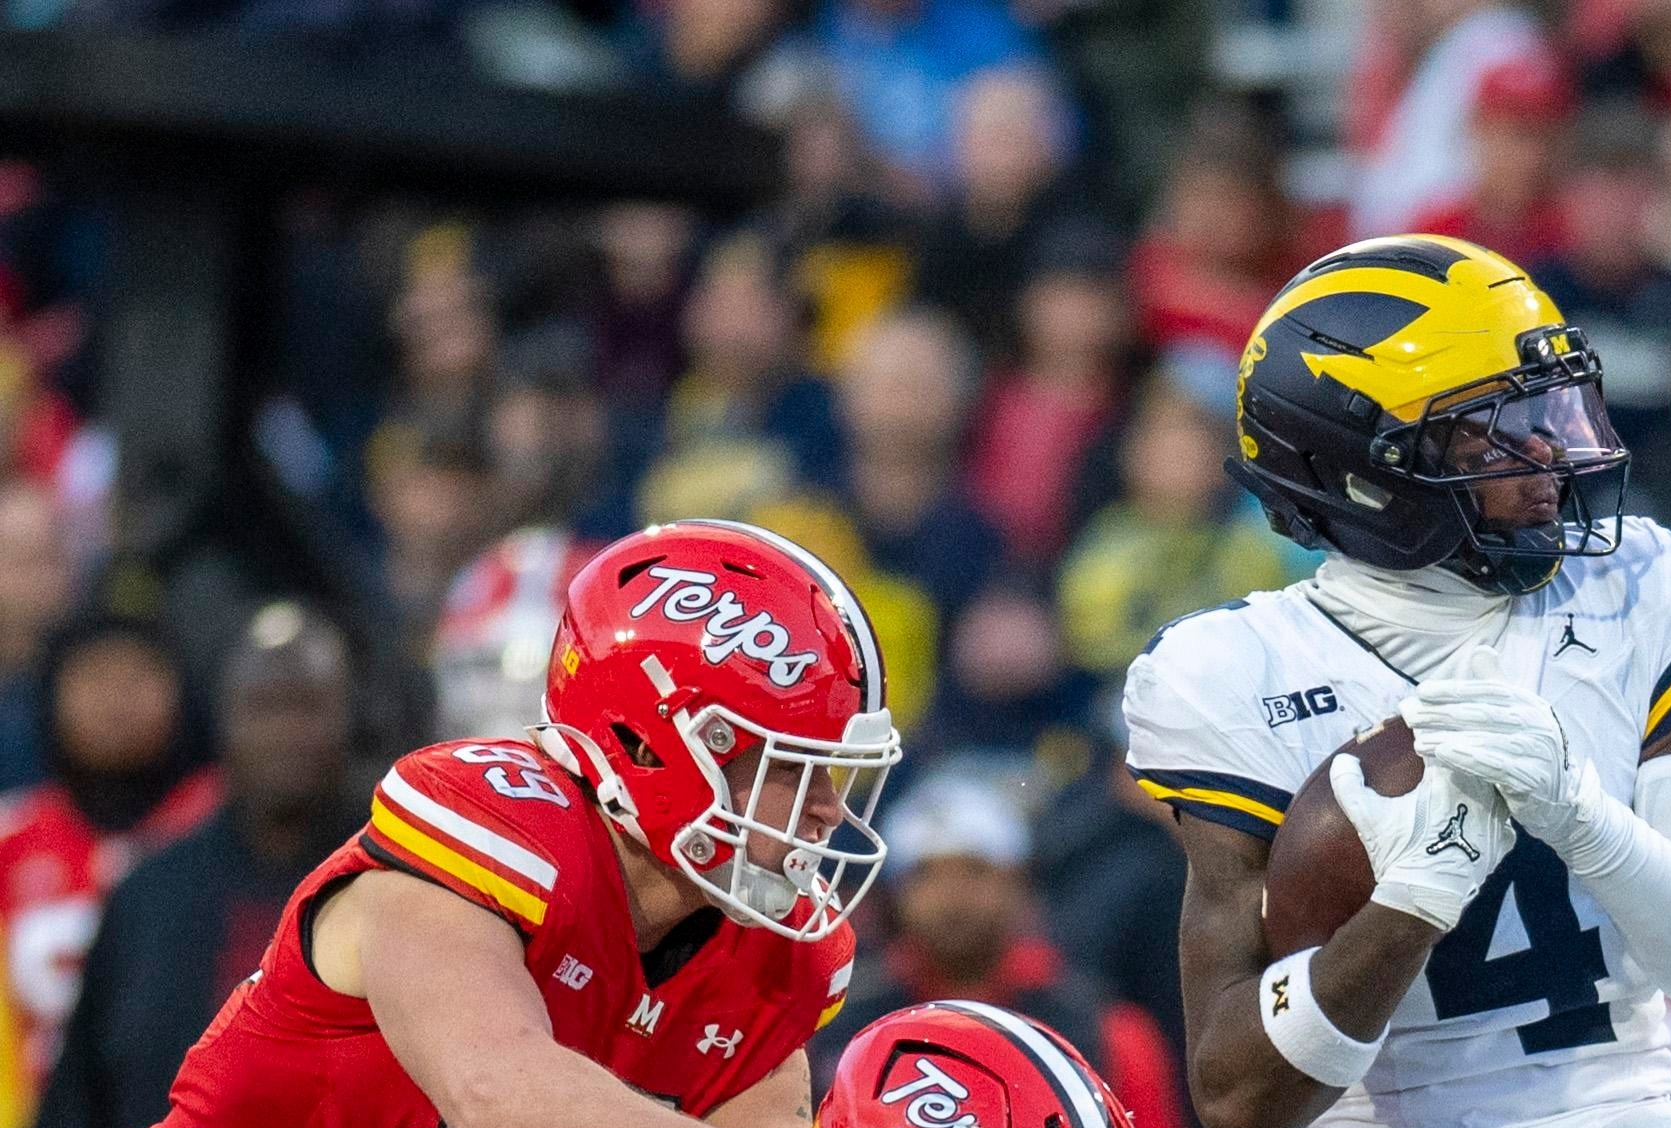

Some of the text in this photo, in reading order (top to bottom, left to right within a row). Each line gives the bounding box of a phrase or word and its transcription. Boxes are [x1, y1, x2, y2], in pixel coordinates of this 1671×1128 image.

[1550, 333, 1572, 356] M
[630, 565, 819, 688] Terps
[451, 744, 571, 809] 89
[1424, 815, 1618, 1056] 4
[626, 993, 665, 1037] M
[1271, 974, 1290, 1017] M
